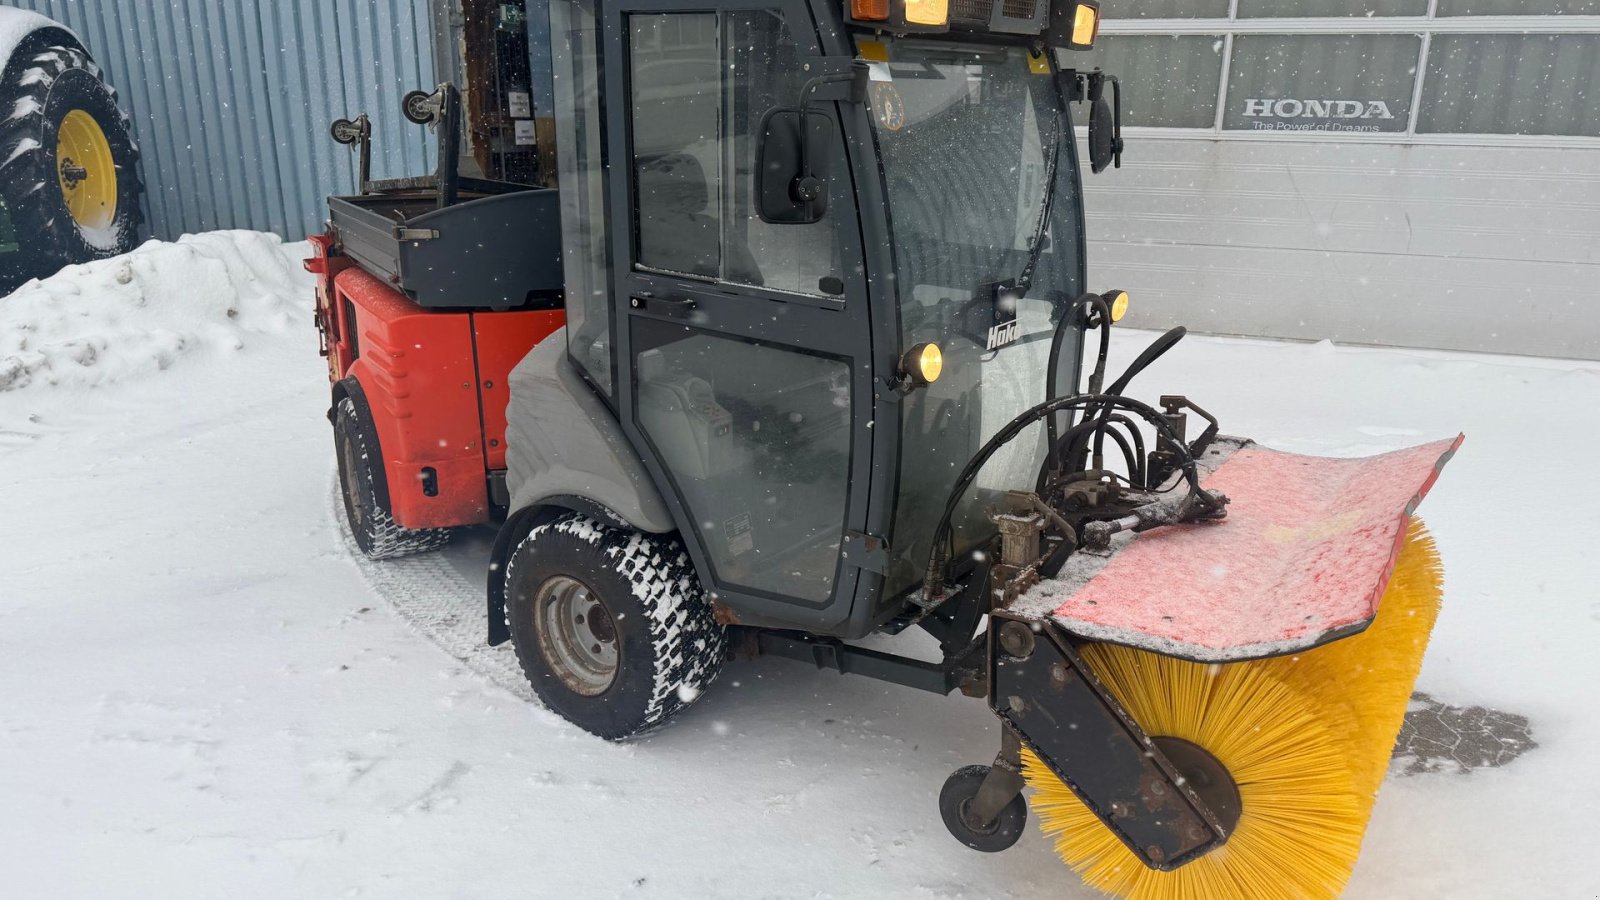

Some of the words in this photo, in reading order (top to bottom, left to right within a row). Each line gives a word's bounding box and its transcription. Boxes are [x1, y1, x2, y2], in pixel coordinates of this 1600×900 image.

[1242, 99, 1394, 119] HONDA
[1252, 121, 1274, 131] The
[1276, 121, 1315, 132] Power
[1316, 121, 1330, 132] of
[1332, 122, 1380, 133] Dreams
